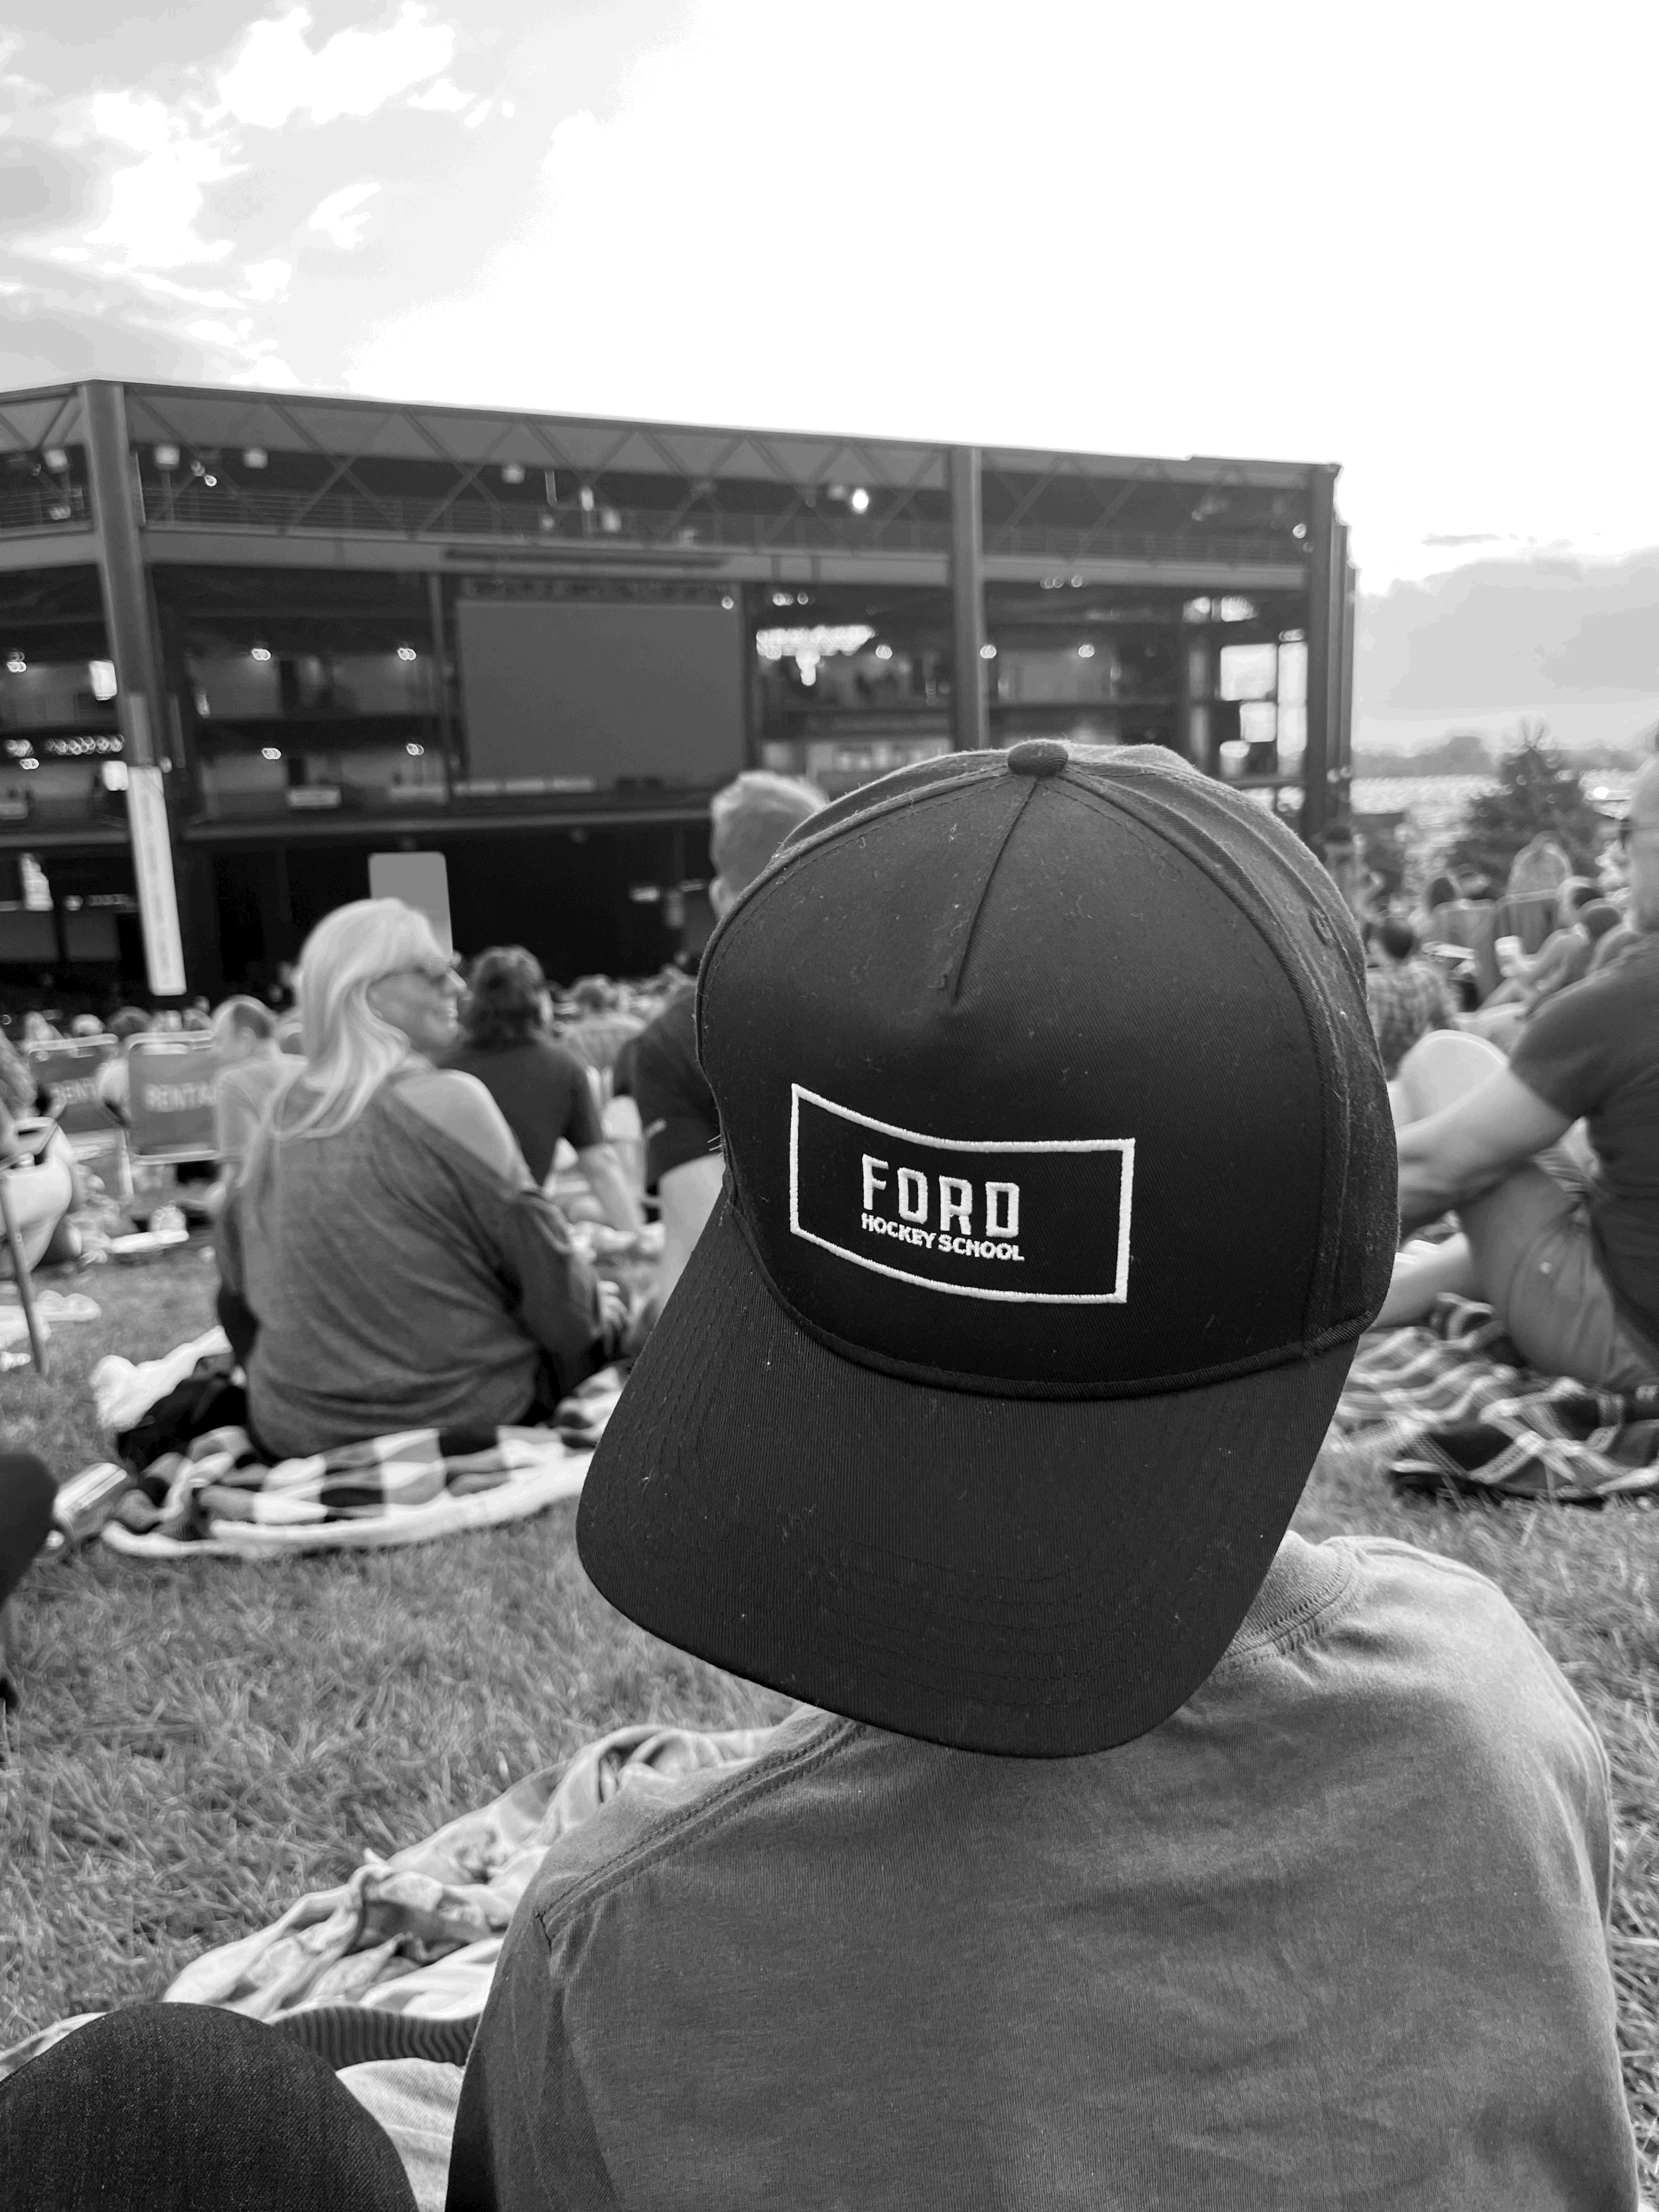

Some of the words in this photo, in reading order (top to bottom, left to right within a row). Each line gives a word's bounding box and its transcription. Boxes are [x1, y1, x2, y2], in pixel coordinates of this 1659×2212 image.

[862, 1153, 1020, 1238] FORD
[861, 1213, 937, 1249] HOCKEY
[938, 1234, 1025, 1261] SCHOOL
